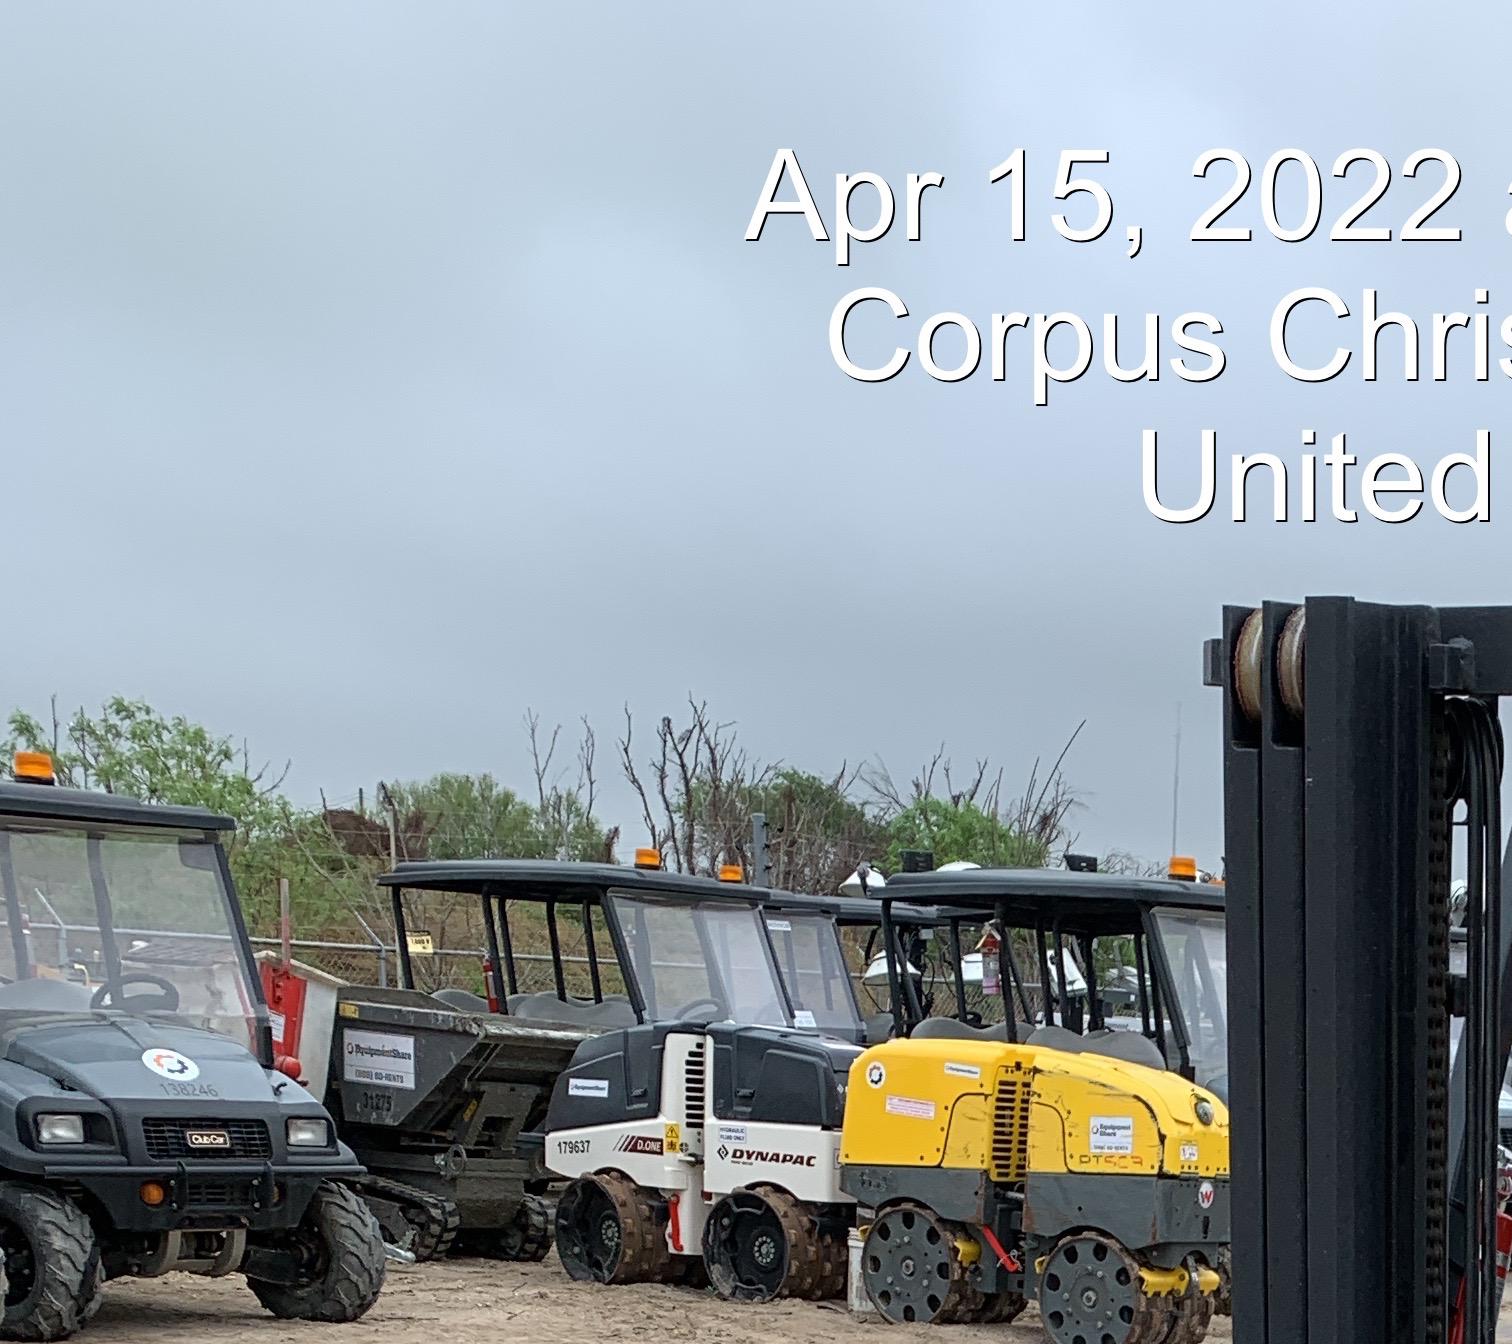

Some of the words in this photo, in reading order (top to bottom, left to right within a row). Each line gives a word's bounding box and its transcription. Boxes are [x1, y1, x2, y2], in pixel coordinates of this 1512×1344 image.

[160, 1083, 219, 1097] 138246
[557, 1140, 591, 1154] 179637
[636, 1139, 662, 1153] D.ONE
[731, 1148, 817, 1167] DYNAPAC
